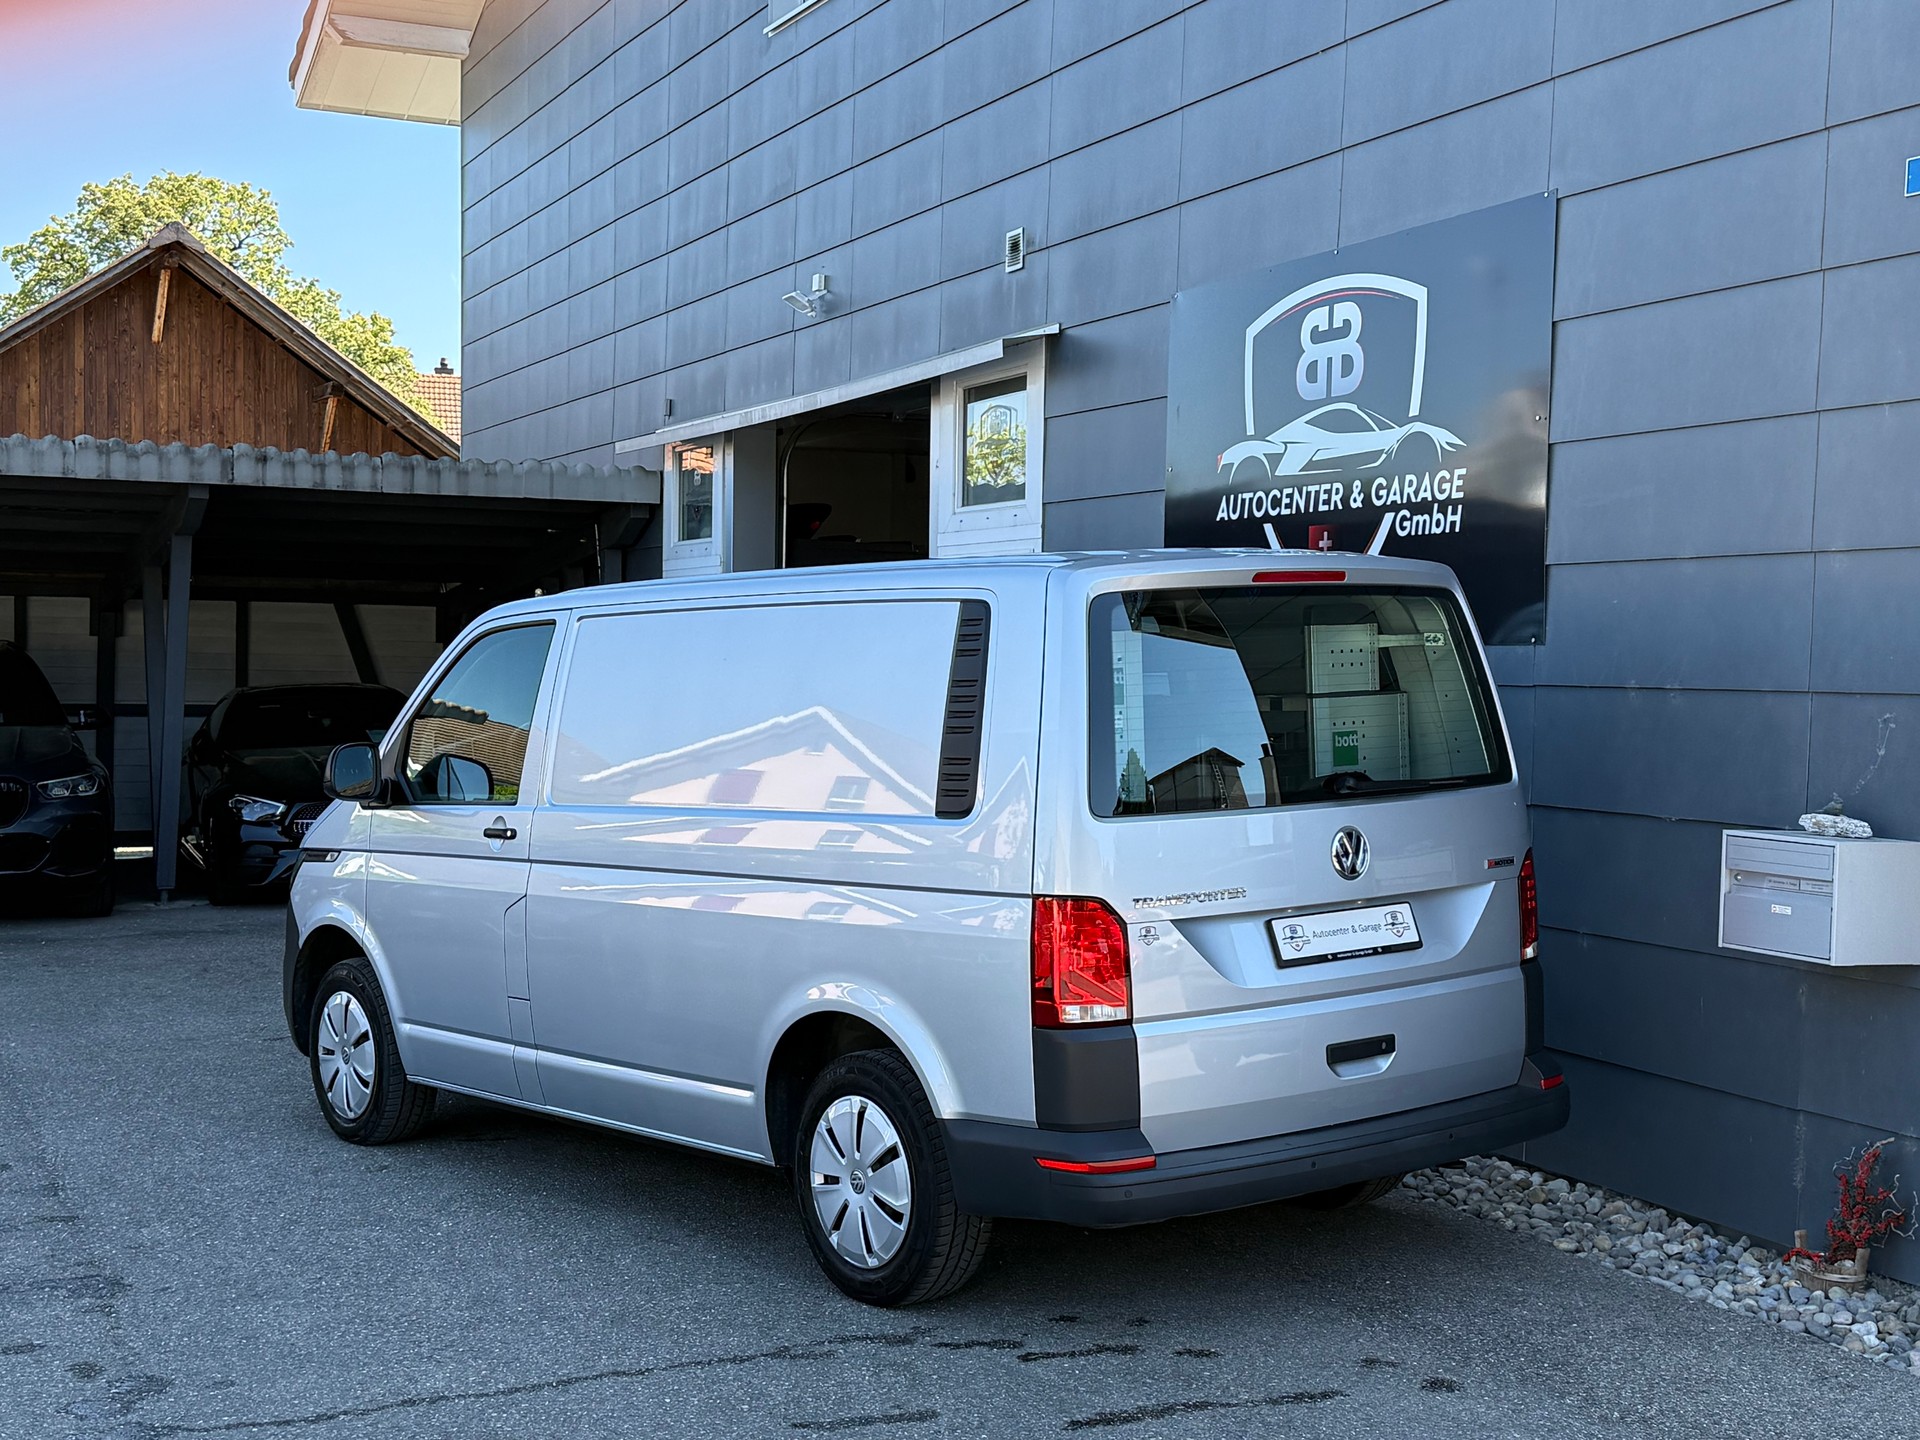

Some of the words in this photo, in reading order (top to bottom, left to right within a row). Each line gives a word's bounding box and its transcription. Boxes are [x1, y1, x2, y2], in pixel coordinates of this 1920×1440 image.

[1216, 482, 1344, 522] AUTOCENTER
[1350, 479, 1363, 508] &
[1371, 468, 1467, 507] GARAGE
[1395, 503, 1463, 537] GmbH
[1335, 734, 1359, 747] bott
[1132, 887, 1247, 909] TRANSPORTER
[1312, 926, 1350, 939] Autocenter
[1351, 924, 1358, 933] &
[1359, 922, 1382, 933] Garage
